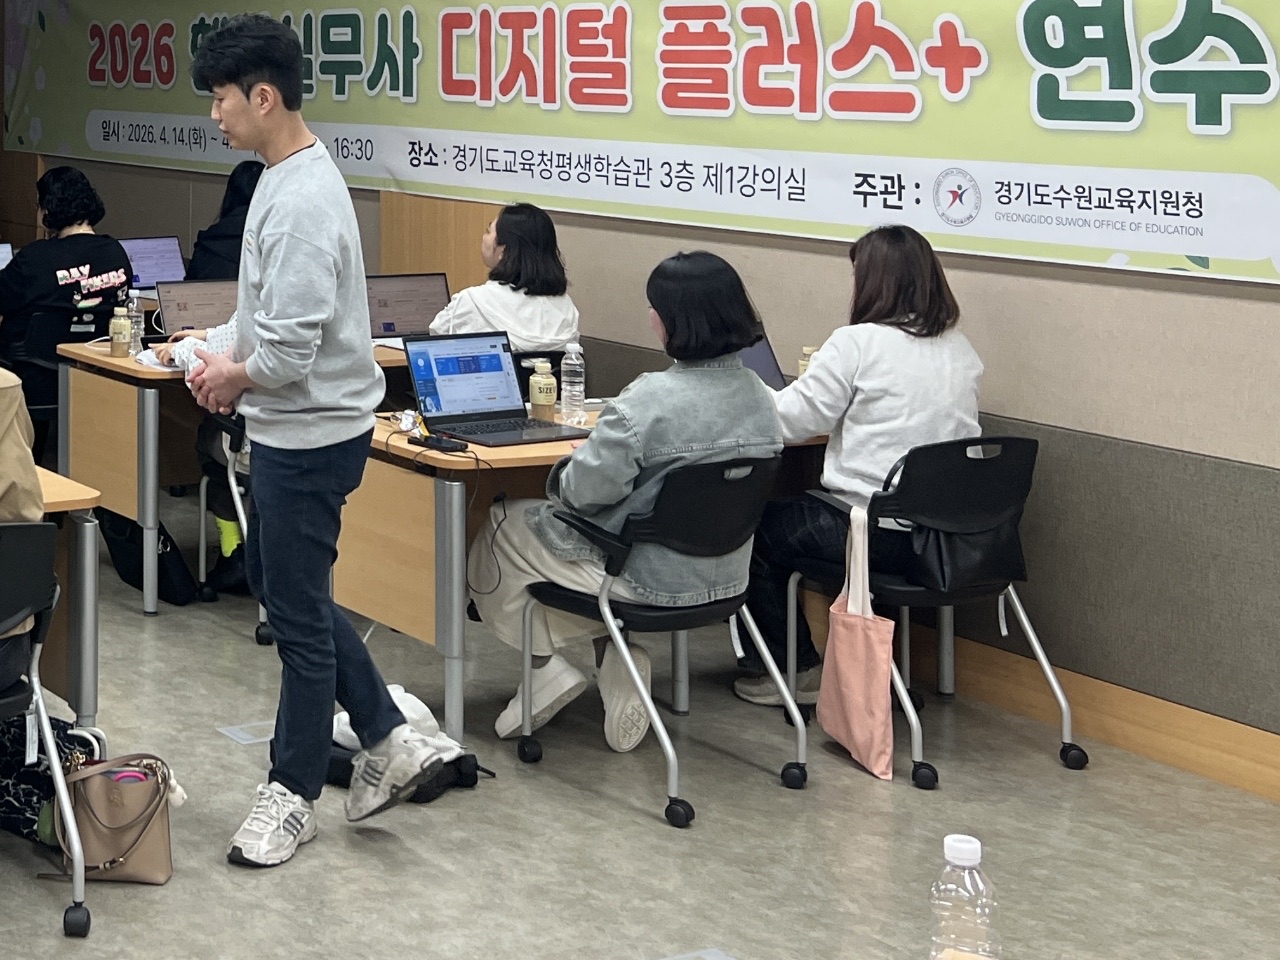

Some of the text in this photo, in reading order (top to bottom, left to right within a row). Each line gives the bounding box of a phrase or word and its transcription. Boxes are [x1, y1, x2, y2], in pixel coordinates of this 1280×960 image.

[88, 21, 176, 87] 2026
[439, 2, 631, 109] 디지털
[101, 119, 120, 142] 일시
[127, 123, 157, 144] 2026.
[333, 137, 374, 161] 16:30
[408, 140, 439, 168] 장소
[452, 144, 652, 188] 경기도교육청평생학습관
[660, 160, 696, 192] 3층
[702, 161, 807, 202] 제1강의실
[852, 171, 906, 210] 주관
[994, 179, 1204, 219] 경기도수원교육지원청
[994, 211, 1204, 237] GYEONGGIDO SUWON OFFICE OF EDUCATION
[537, 386, 553, 394] SIZE
